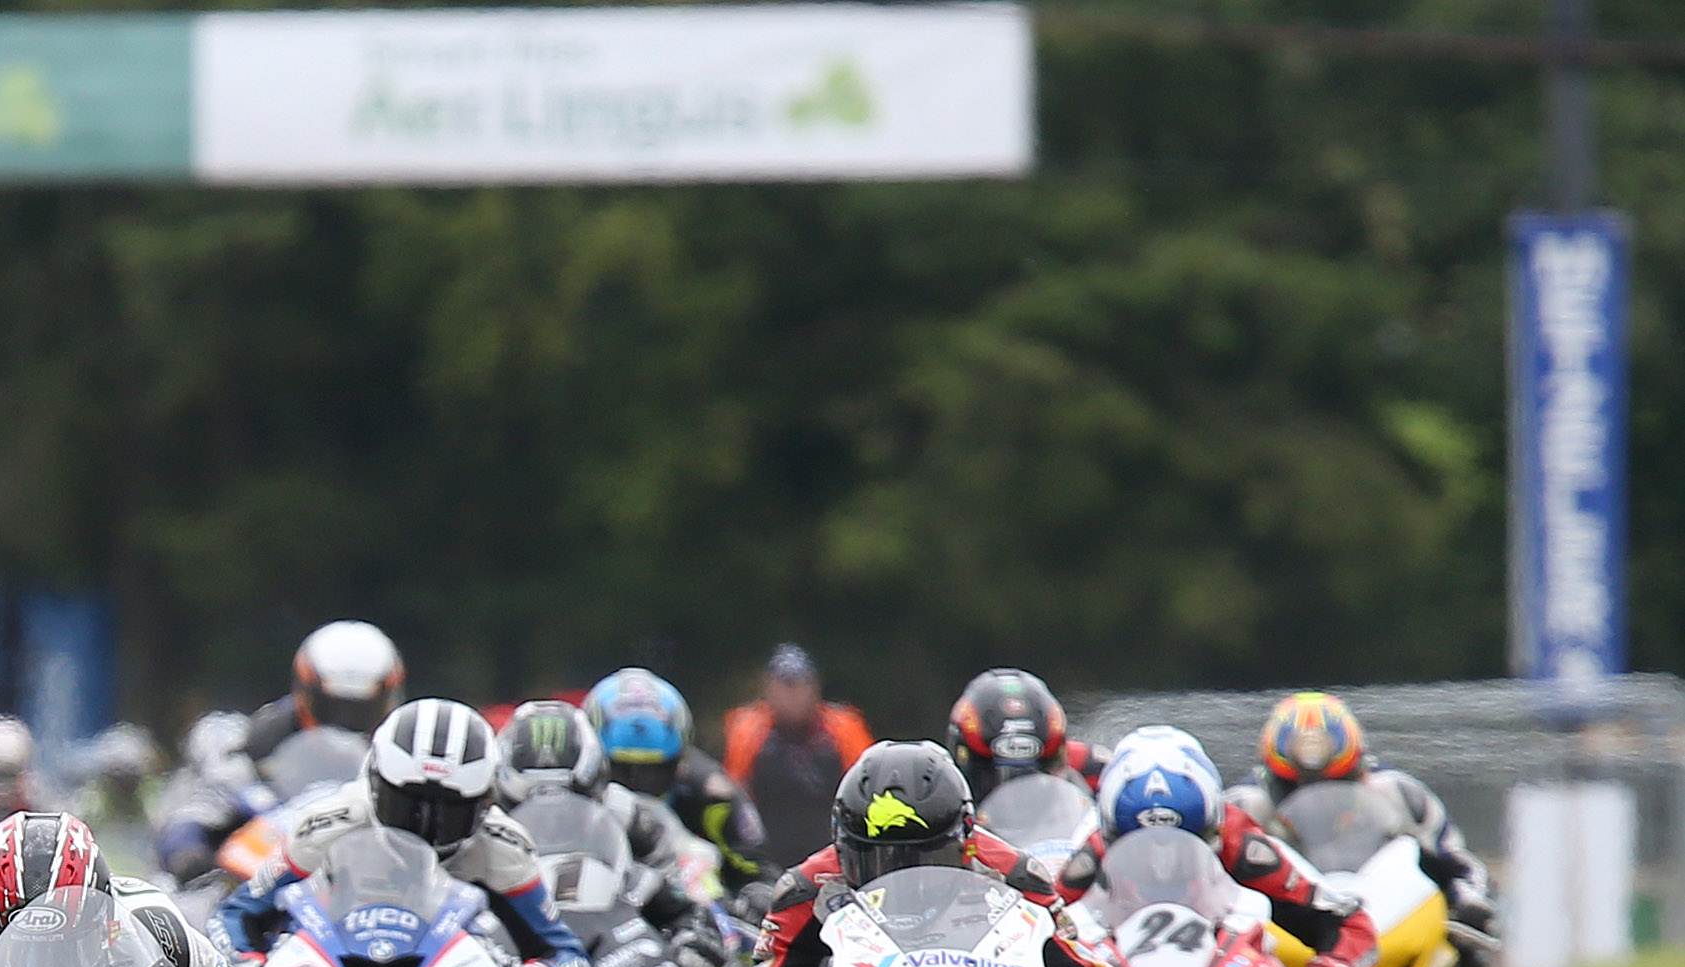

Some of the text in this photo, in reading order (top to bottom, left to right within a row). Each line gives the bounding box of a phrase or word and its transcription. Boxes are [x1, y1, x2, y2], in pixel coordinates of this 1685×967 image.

[349, 68, 484, 137] Aer
[14, 910, 56, 926] Arai
[343, 908, 420, 932] tyco
[1126, 910, 1208, 960] 24
